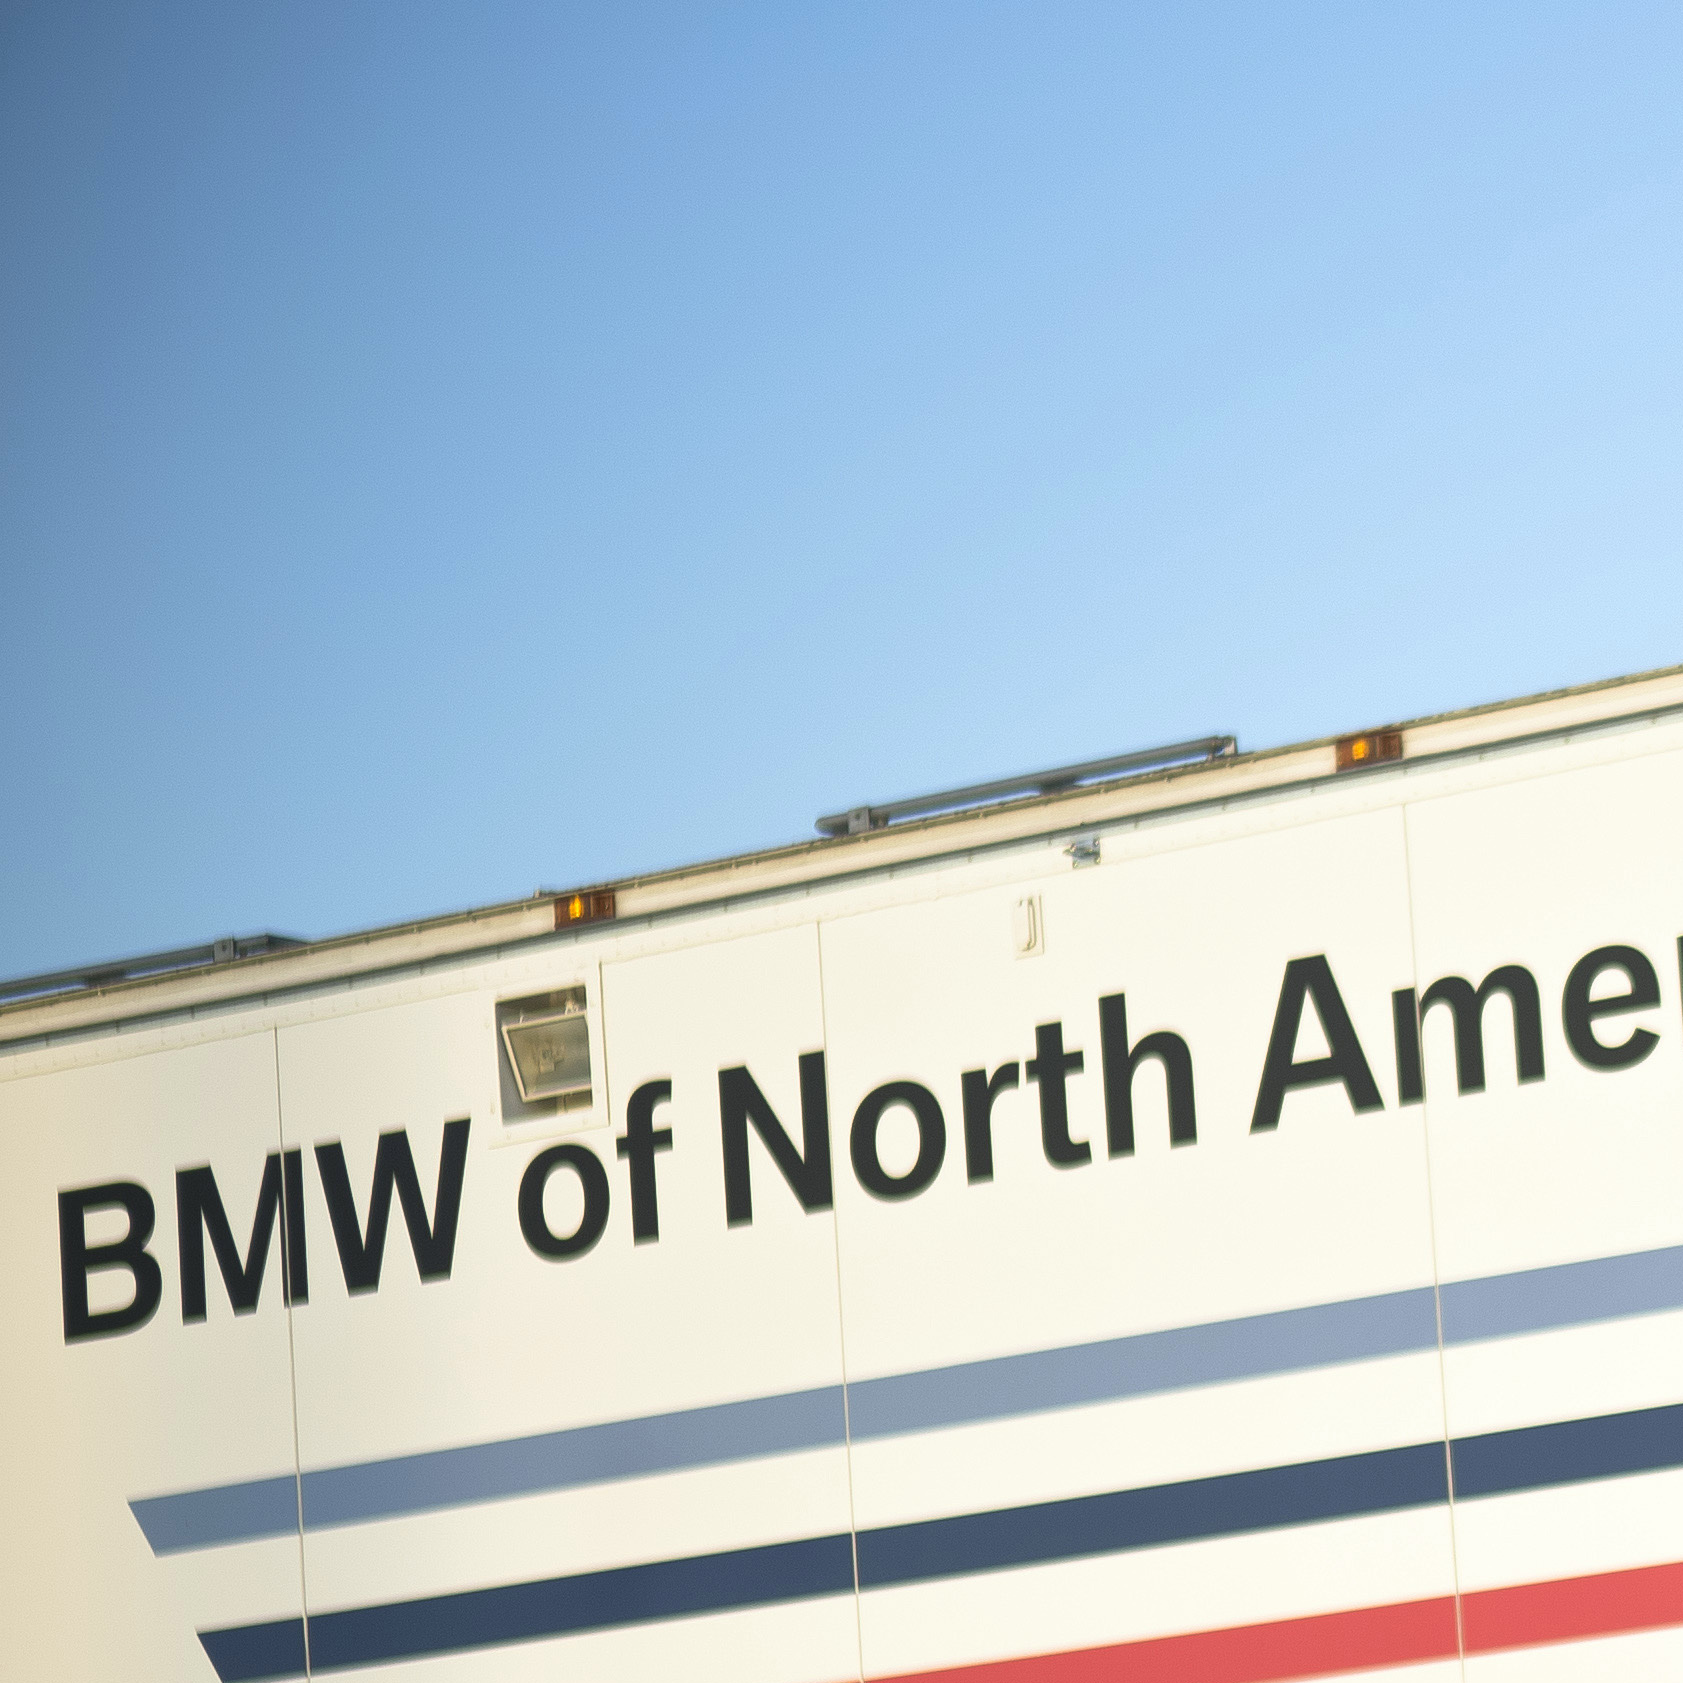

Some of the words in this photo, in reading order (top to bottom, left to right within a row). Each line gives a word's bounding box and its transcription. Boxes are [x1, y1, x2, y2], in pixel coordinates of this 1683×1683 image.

[58, 1118, 471, 1345] BMW
[517, 1078, 673, 1263] of
[719, 993, 1199, 1230] North
